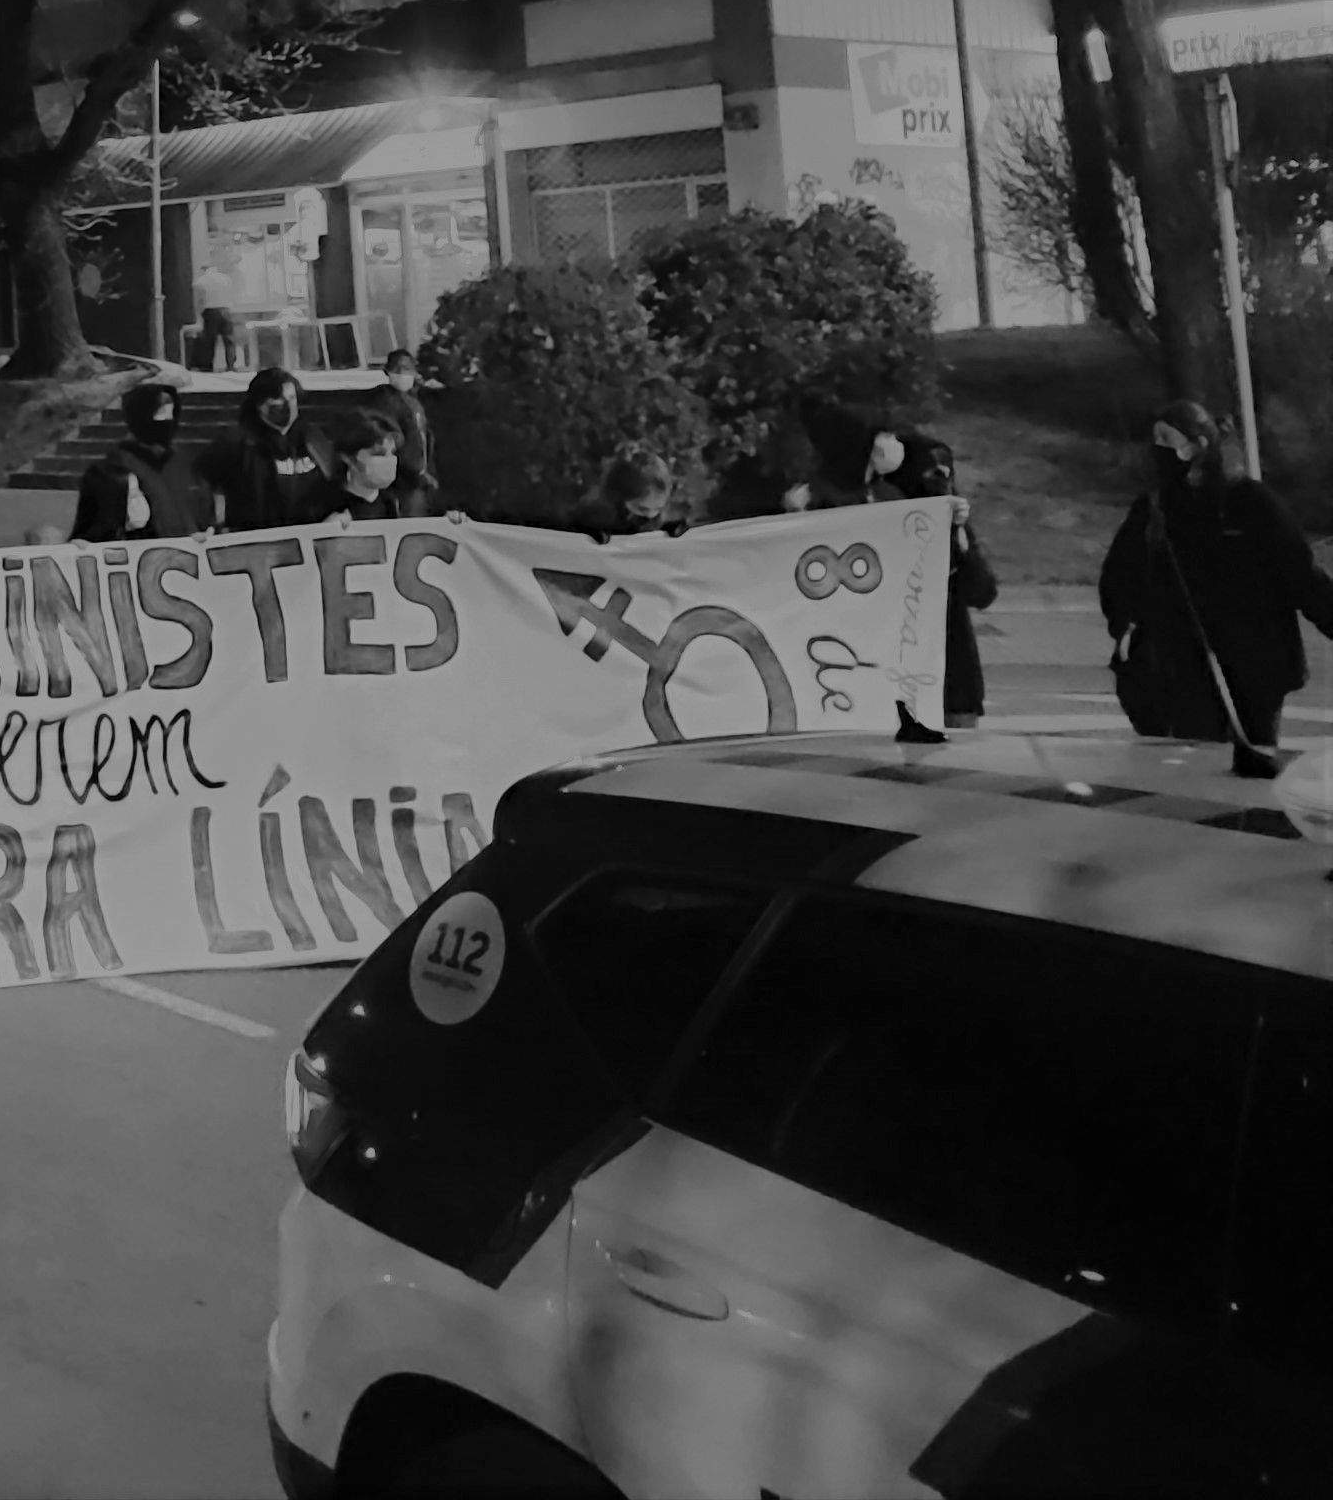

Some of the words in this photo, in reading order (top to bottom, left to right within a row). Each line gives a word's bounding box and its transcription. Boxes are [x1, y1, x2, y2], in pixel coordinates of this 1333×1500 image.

[902, 102, 951, 139] prix
[794, 542, 883, 601] 8
[426, 921, 491, 977] 112
